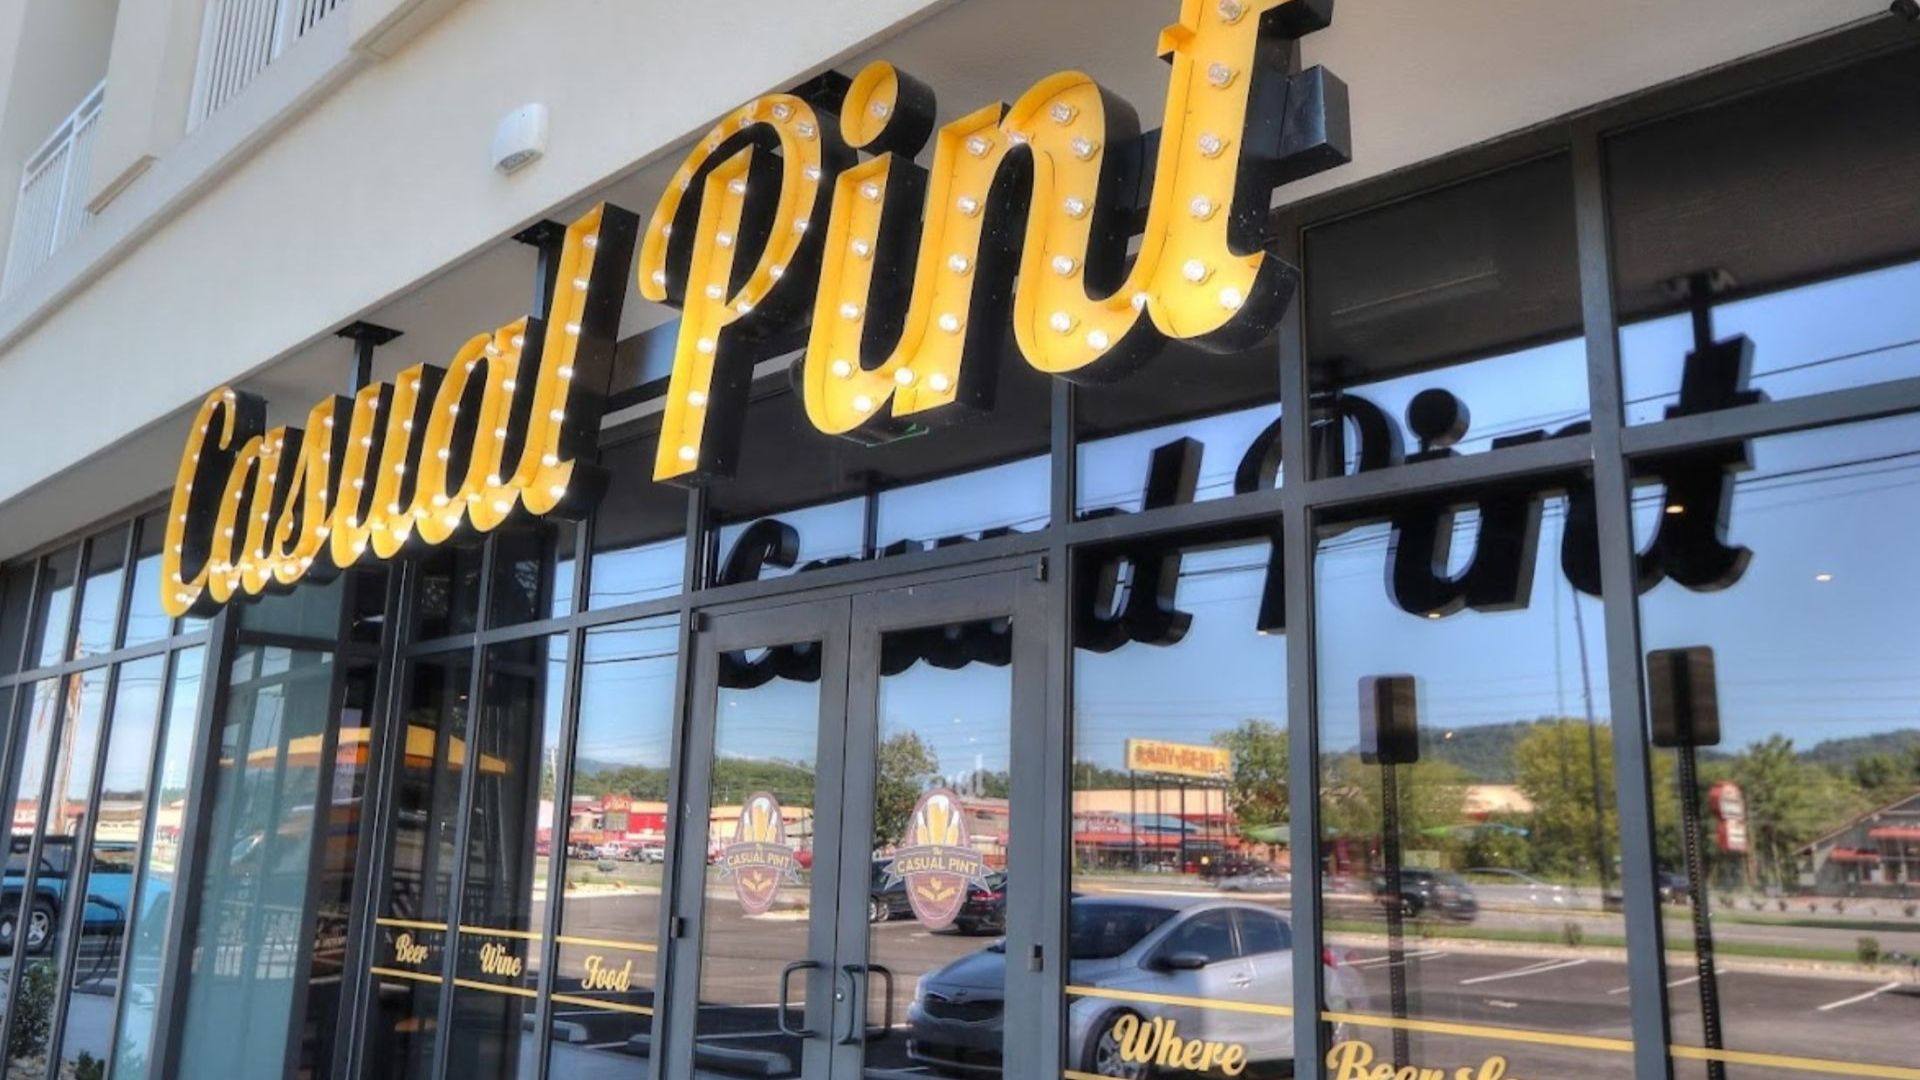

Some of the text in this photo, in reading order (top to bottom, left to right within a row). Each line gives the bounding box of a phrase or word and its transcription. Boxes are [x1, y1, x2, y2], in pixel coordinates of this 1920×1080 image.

[162, 0, 1290, 618] Casual Pint
[728, 851, 790, 868] CASUAL PINT
[897, 857, 978, 875] CASUAL PINT
[395, 933, 632, 992] Beer Wine Food
[1112, 1013, 1248, 1077] Where
